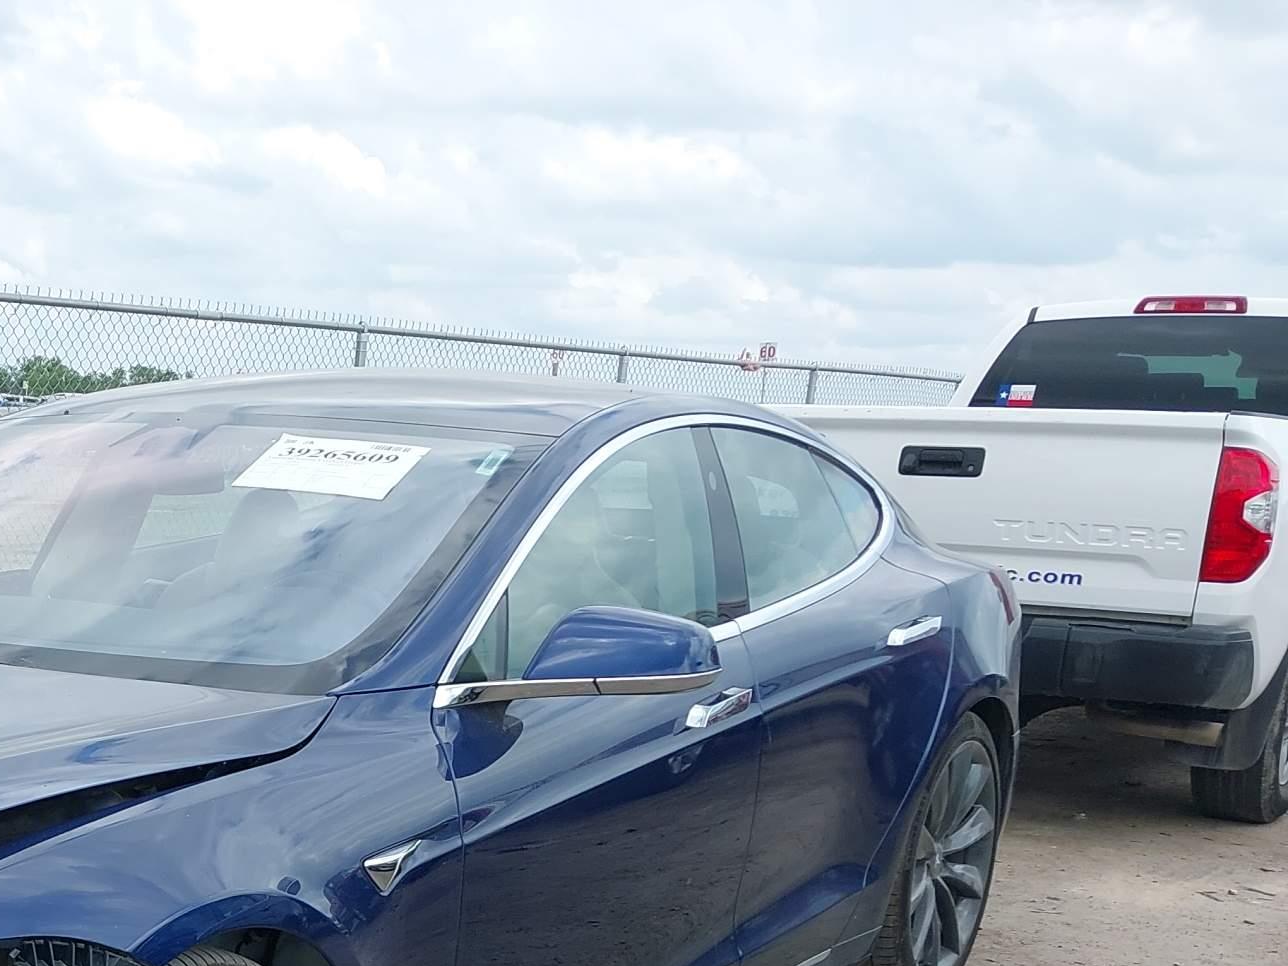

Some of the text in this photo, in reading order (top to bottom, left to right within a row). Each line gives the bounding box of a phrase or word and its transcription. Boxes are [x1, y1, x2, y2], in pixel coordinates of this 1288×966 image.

[277, 447, 400, 464] 39265609
[992, 518, 1190, 551] TUNDRA
[998, 565, 1083, 586] c.com
